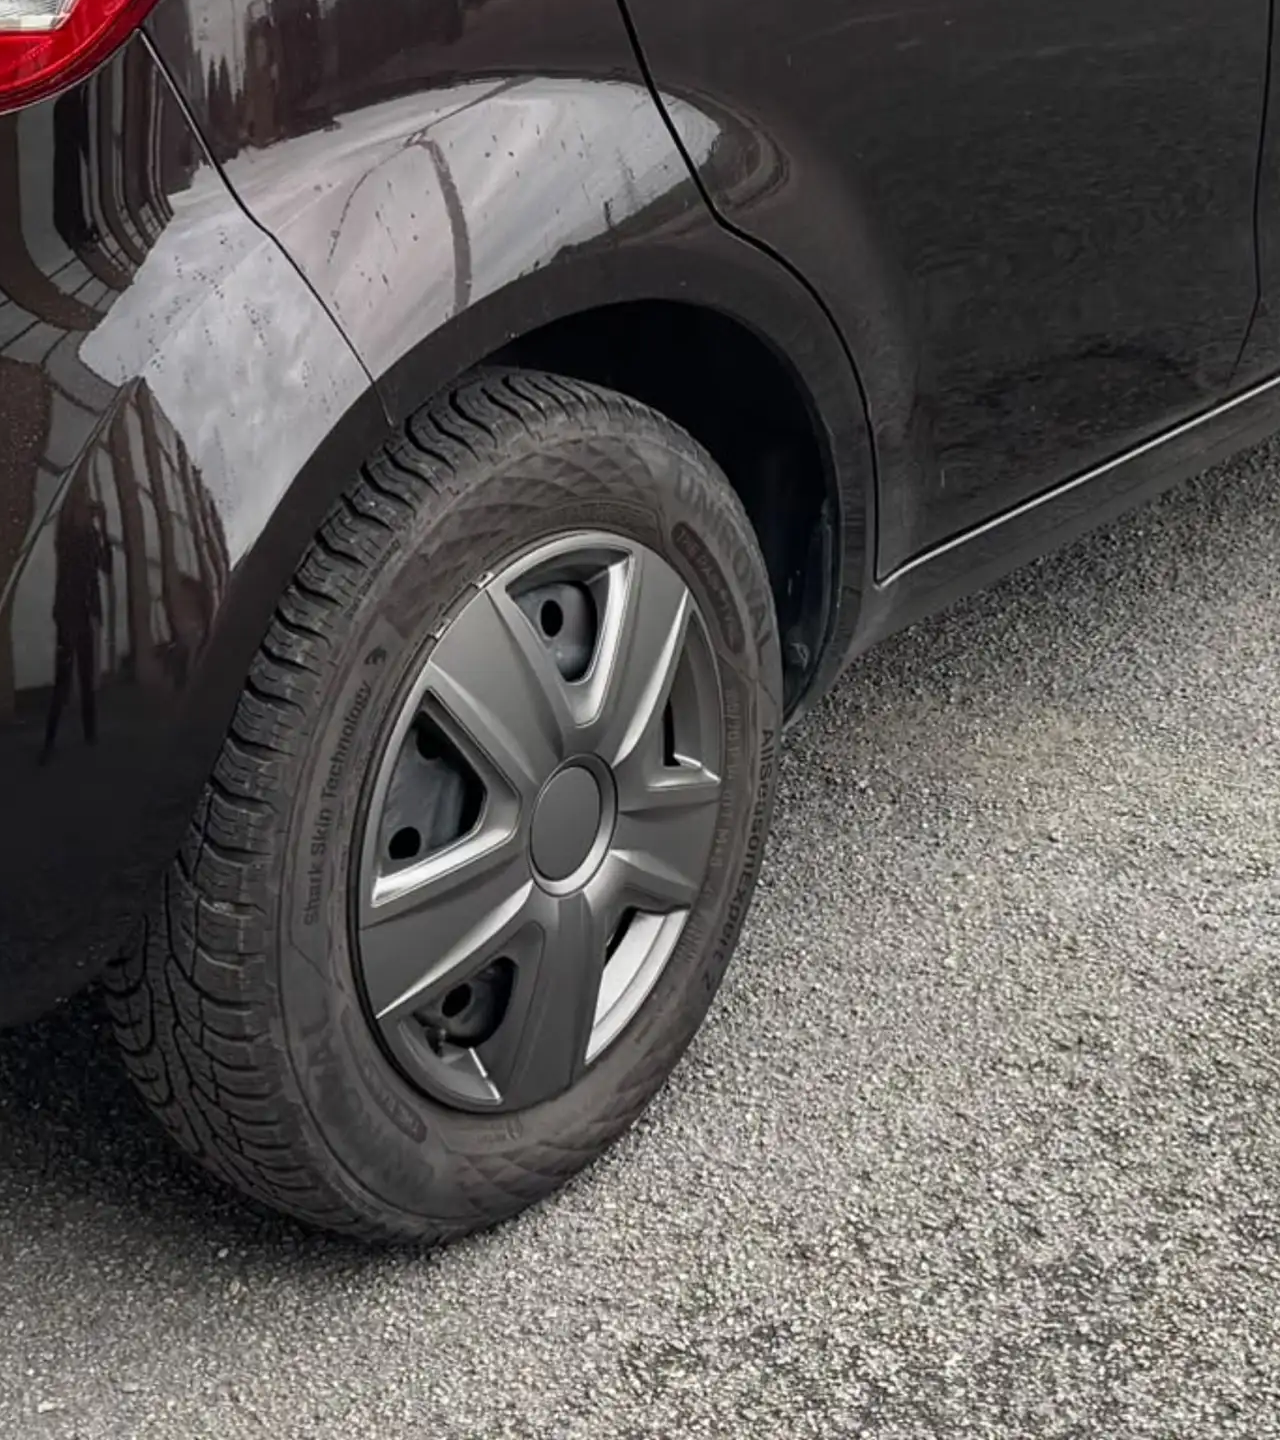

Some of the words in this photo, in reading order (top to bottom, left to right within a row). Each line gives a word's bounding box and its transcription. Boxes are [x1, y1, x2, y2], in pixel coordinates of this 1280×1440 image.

[322, 679, 371, 804] Technology
[311, 808, 332, 856] Skin
[303, 863, 322, 927] Shark
